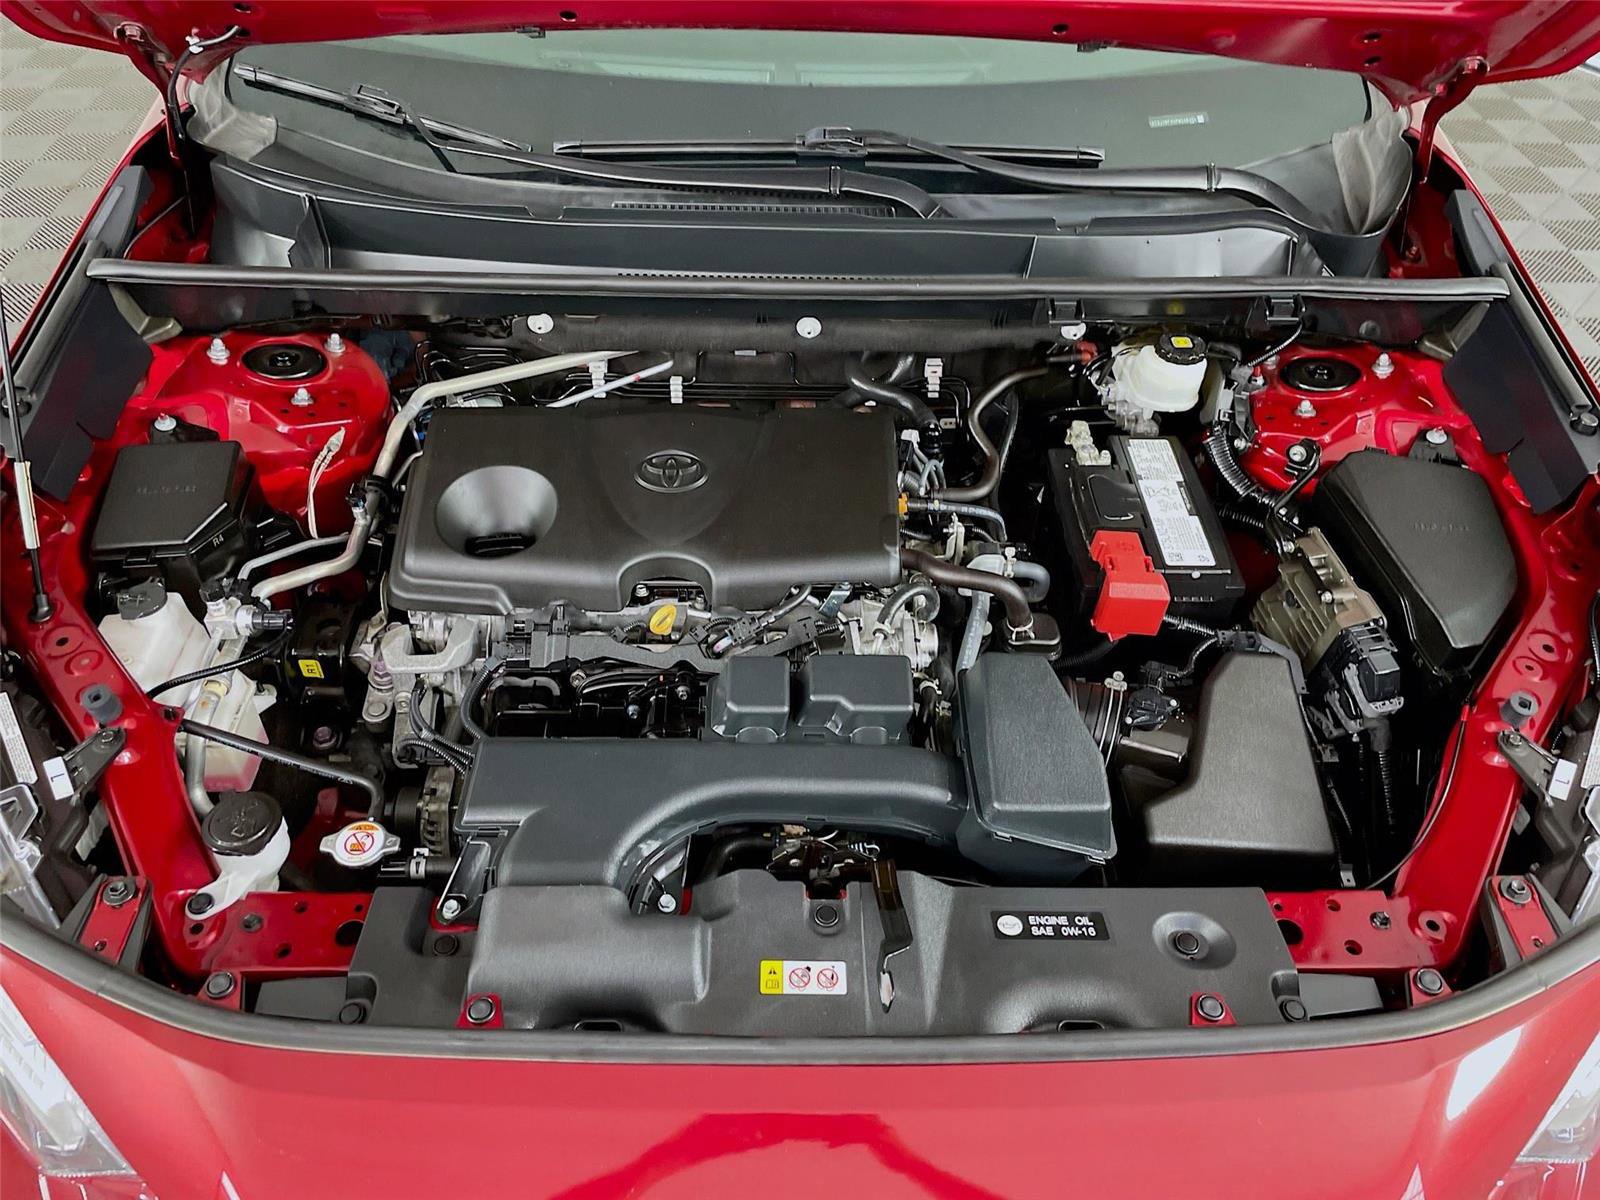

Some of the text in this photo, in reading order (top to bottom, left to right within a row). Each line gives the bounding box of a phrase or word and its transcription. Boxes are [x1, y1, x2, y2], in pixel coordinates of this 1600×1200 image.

[1028, 915, 1094, 926] ENGINE OIL
[1031, 926, 1055, 936] SAE
